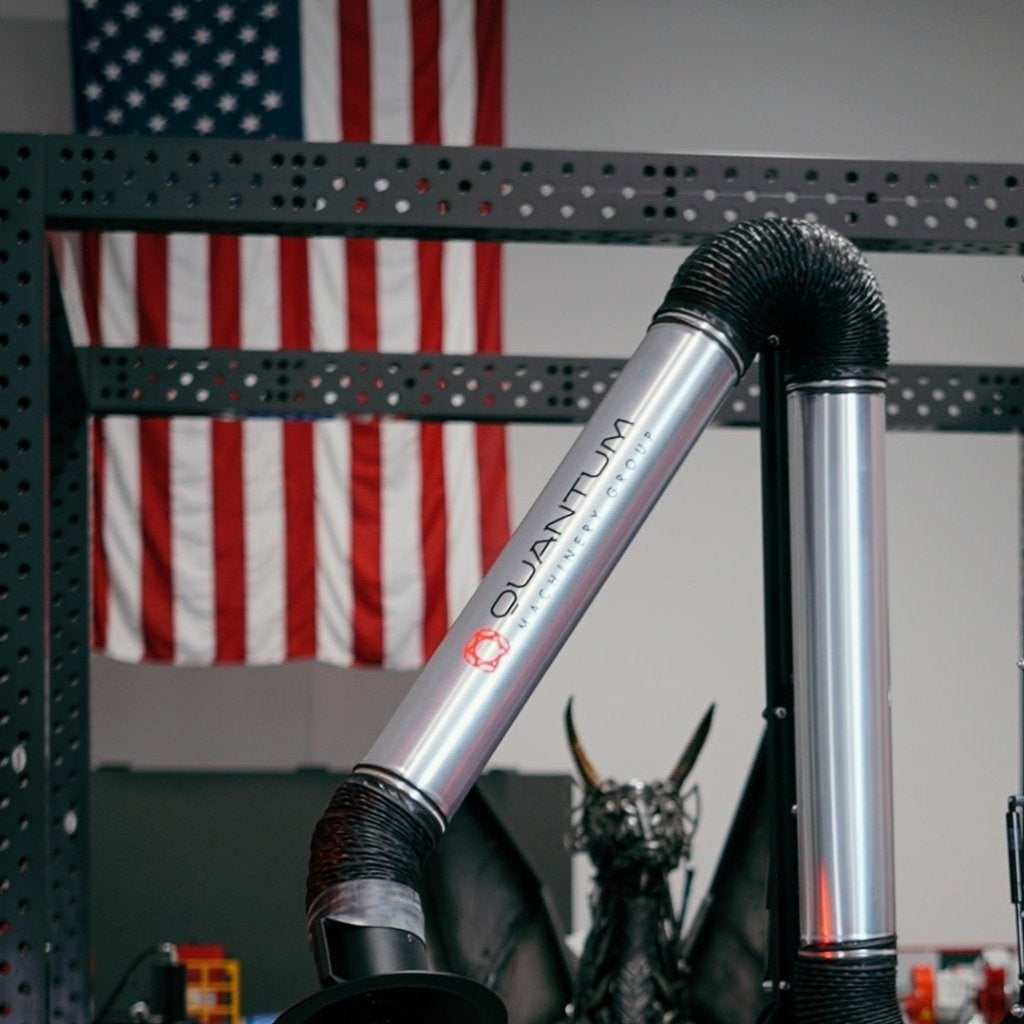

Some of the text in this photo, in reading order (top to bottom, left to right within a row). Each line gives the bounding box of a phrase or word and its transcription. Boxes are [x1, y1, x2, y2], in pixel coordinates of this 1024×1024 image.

[491, 418, 635, 618] QUANTUM
[518, 431, 654, 629] MACHINERY GROUP
